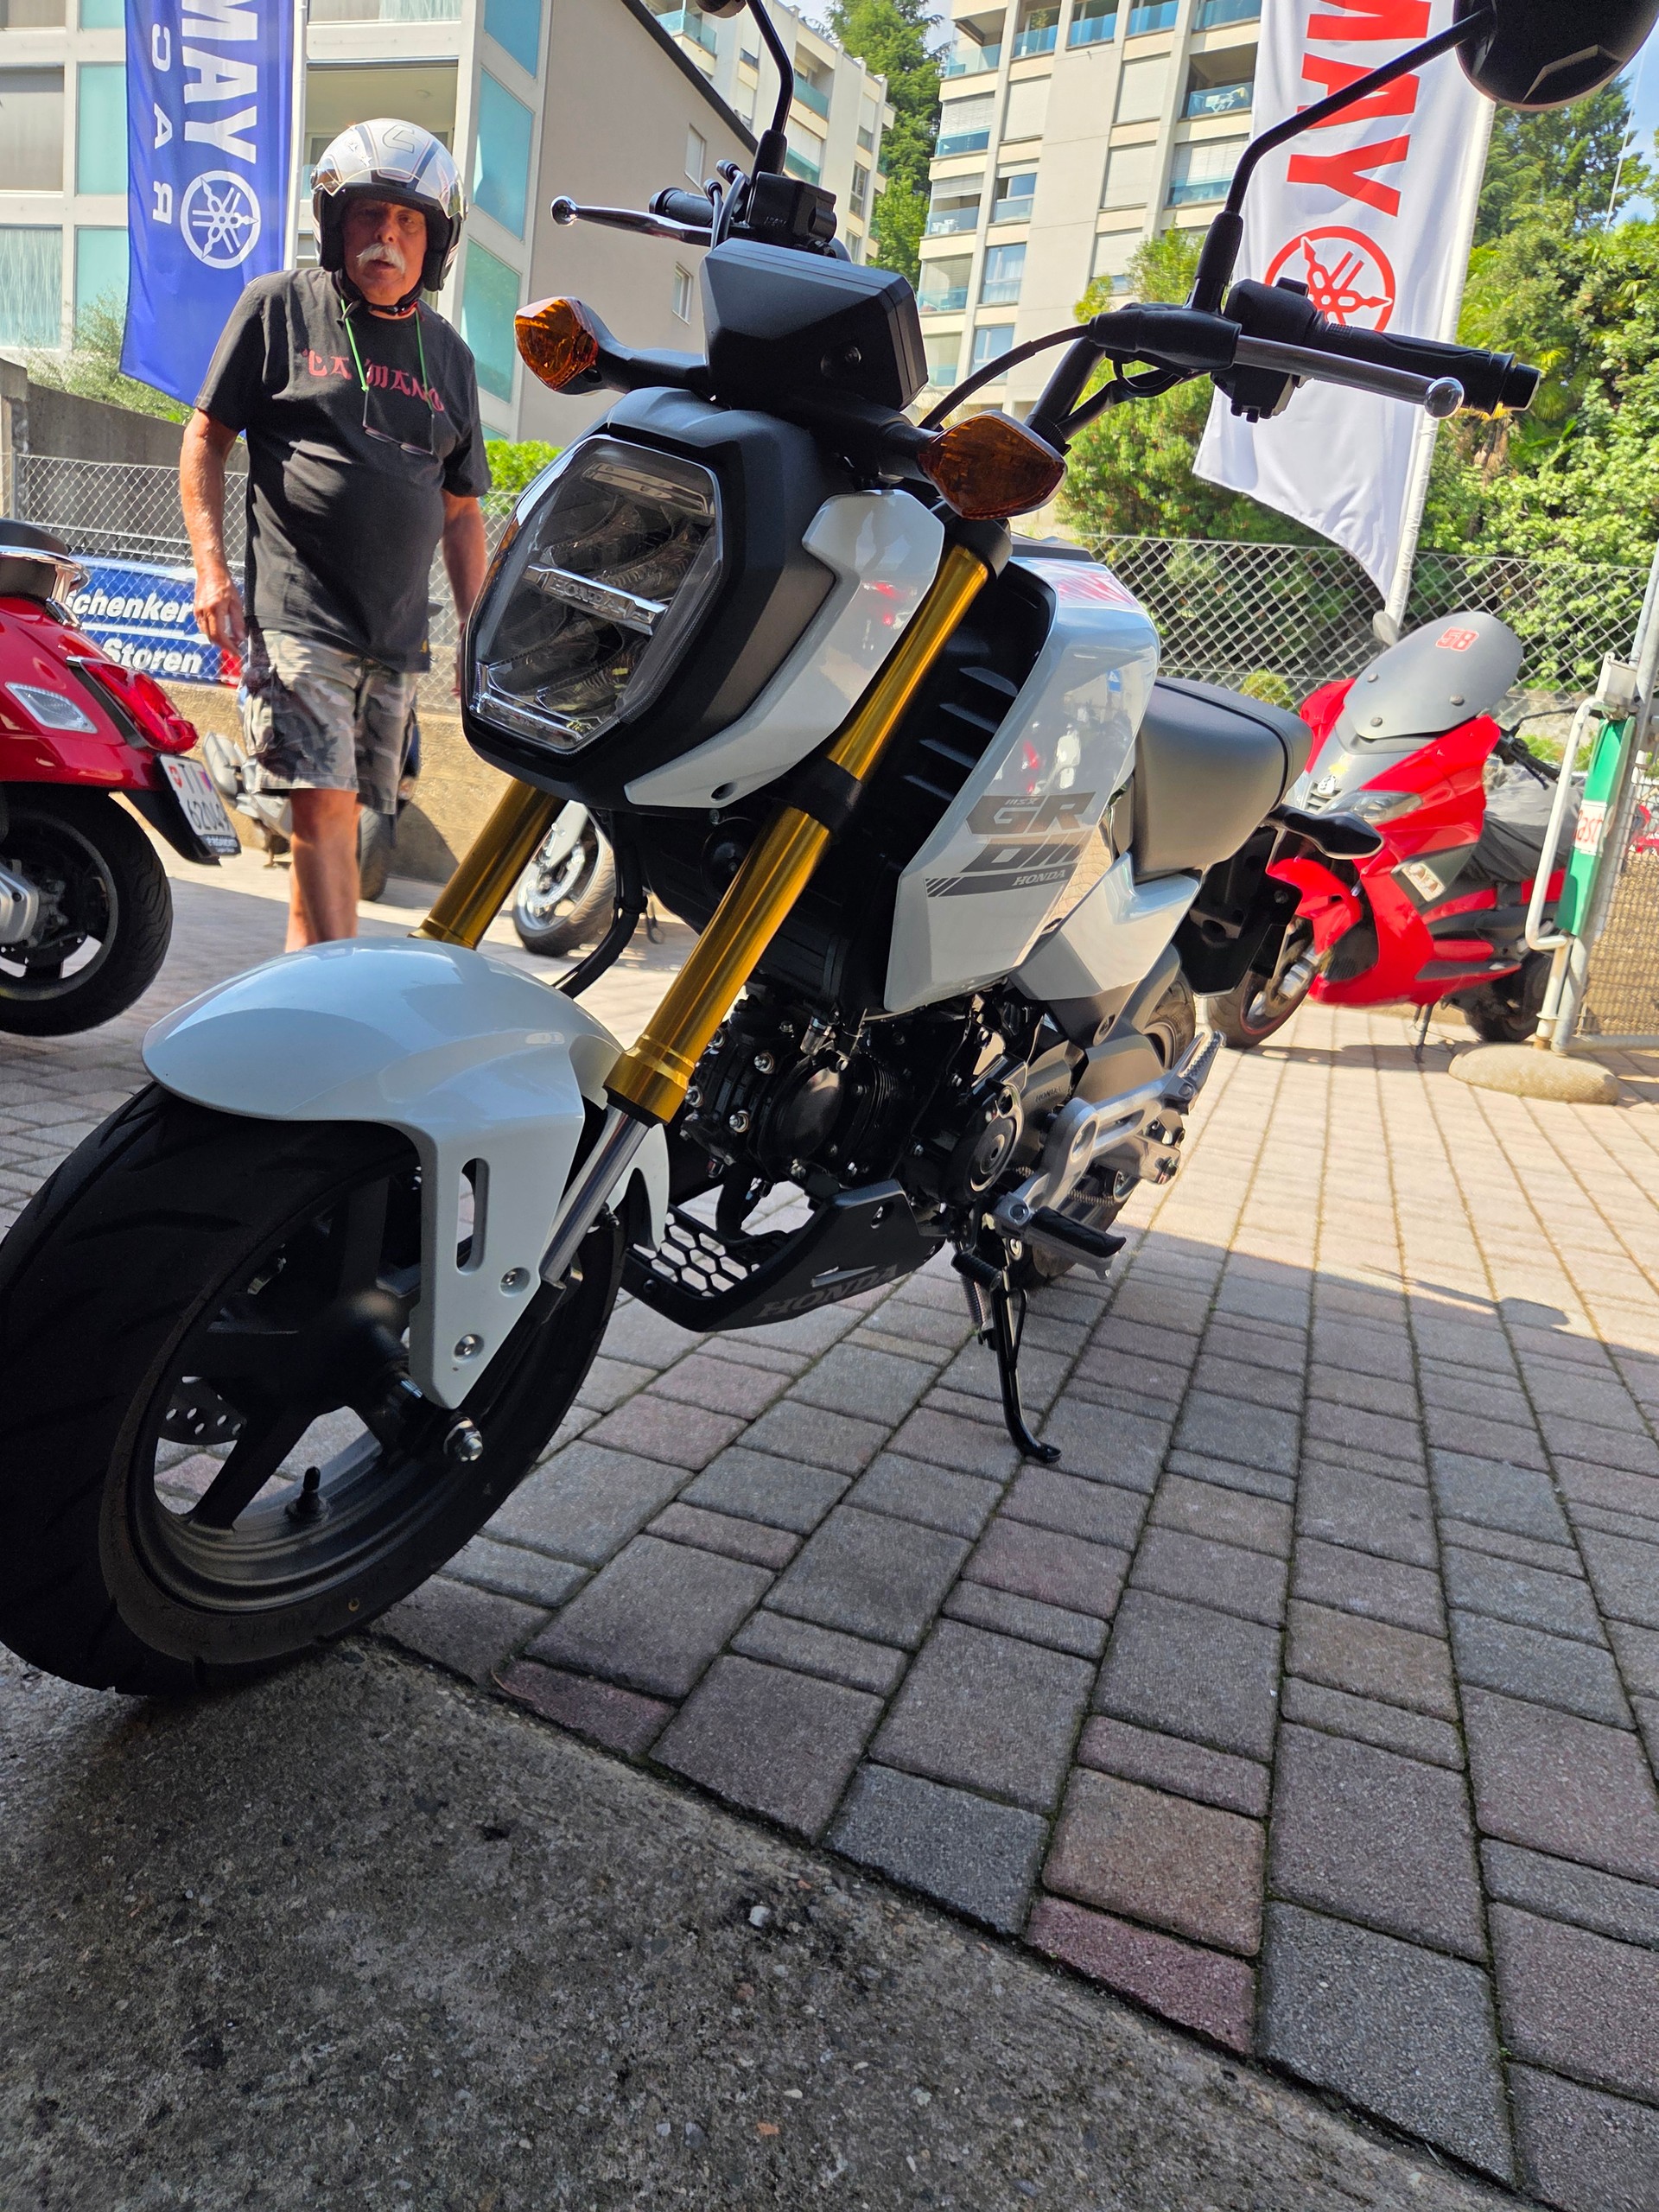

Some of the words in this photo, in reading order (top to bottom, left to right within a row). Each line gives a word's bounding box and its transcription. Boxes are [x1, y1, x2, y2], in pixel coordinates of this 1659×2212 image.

[1435, 626, 1479, 652] 58
[102, 638, 204, 674] Storen
[1012, 870, 1066, 887] HONDA
[753, 1264, 898, 1319] HONDA
